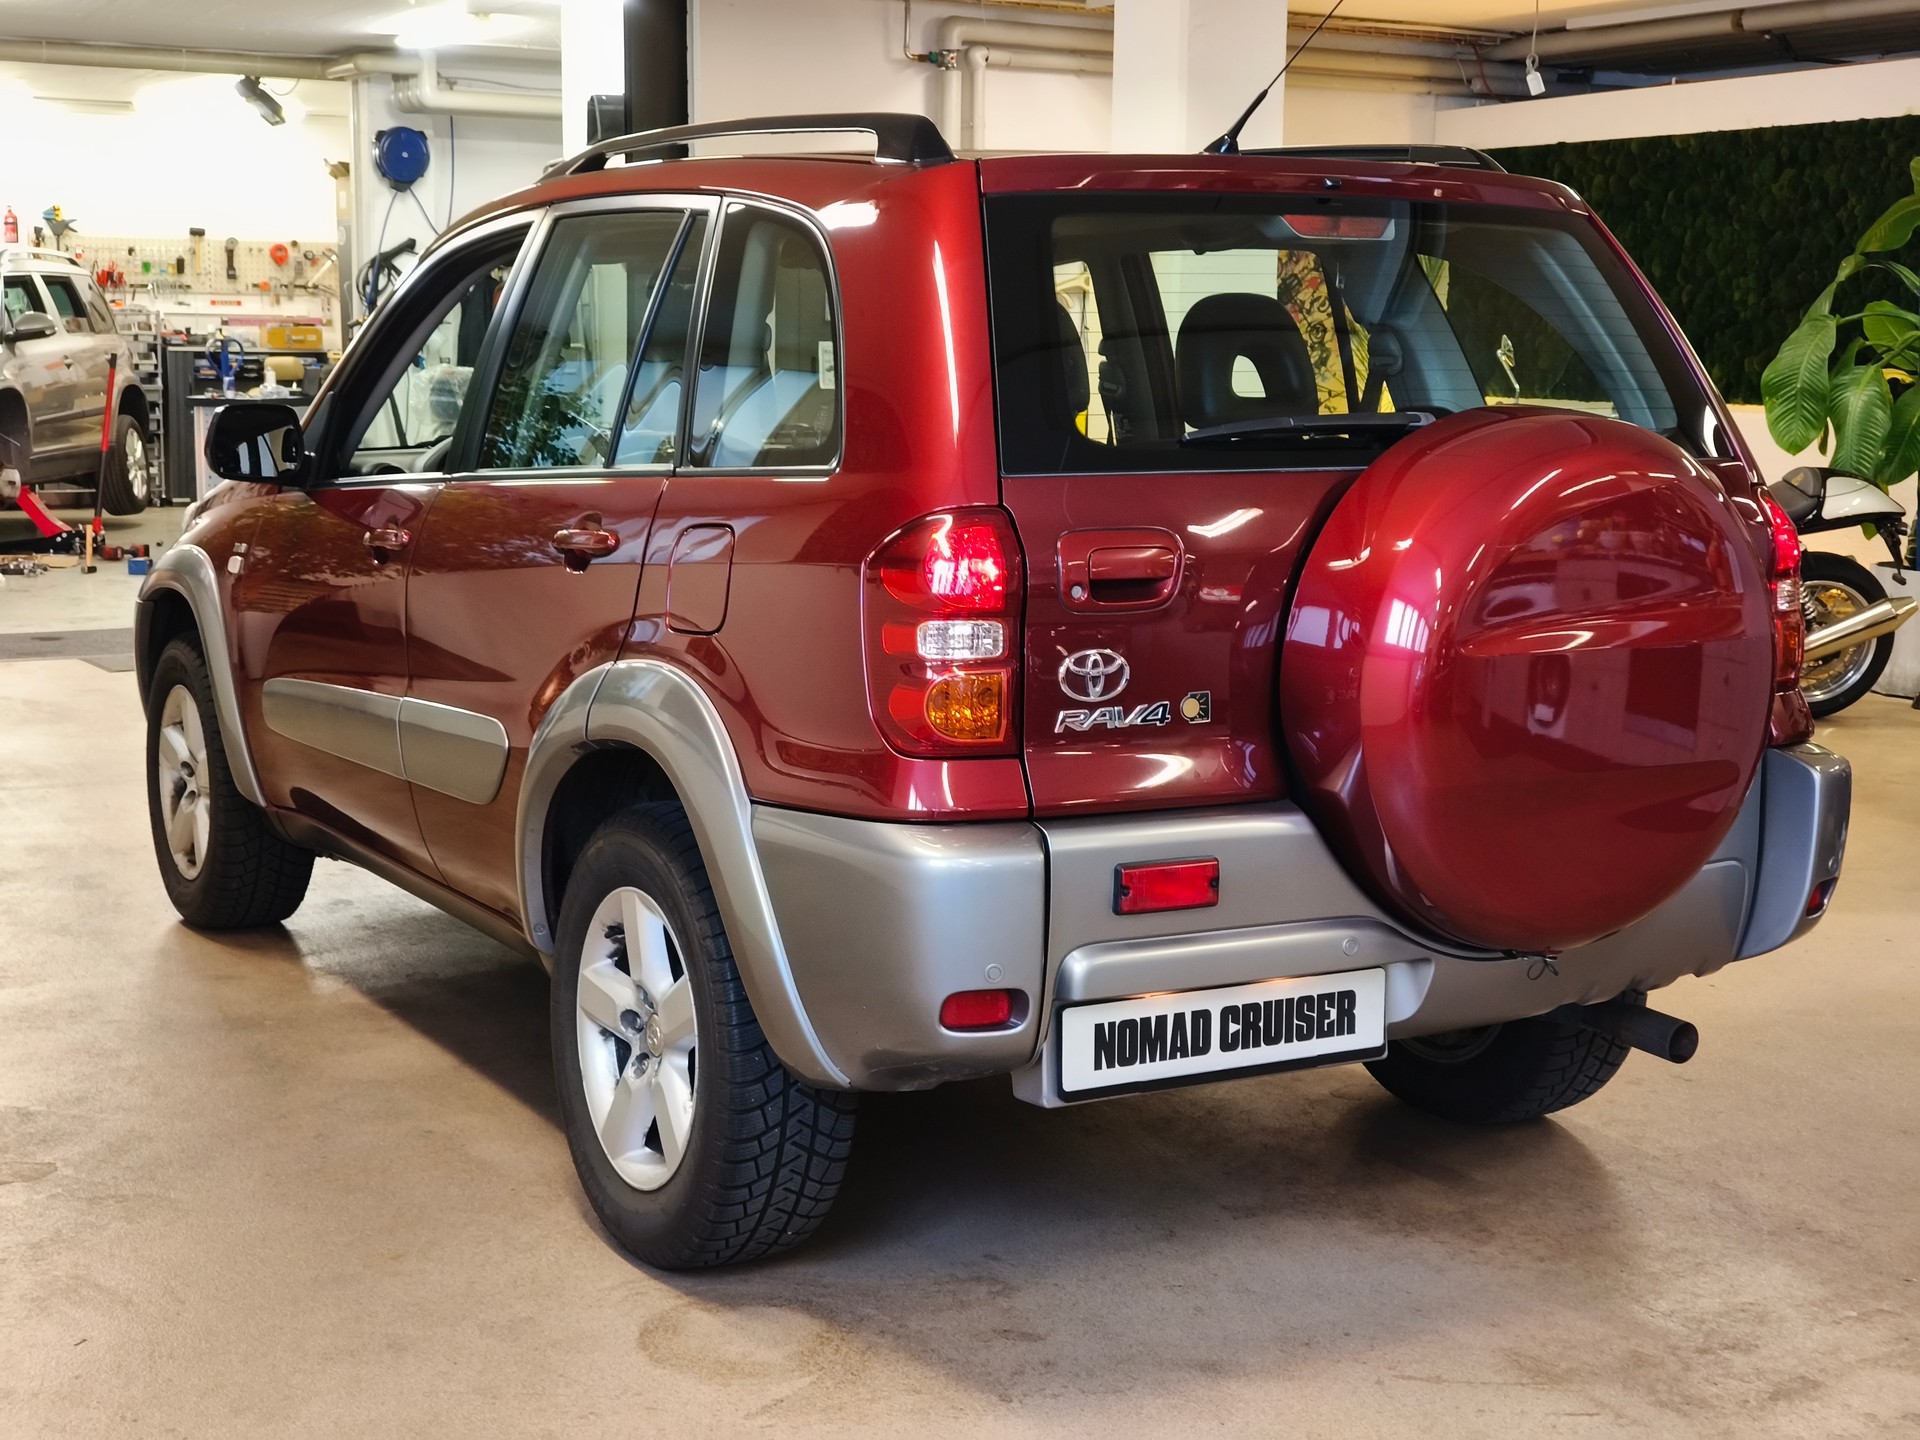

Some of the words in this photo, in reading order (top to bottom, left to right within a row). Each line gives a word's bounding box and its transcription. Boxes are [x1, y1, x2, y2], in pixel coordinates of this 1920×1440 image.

[1054, 701, 1170, 733] RAV4
[1094, 1009, 1212, 1071] NOMAD
[1219, 990, 1356, 1053] CRUISER
